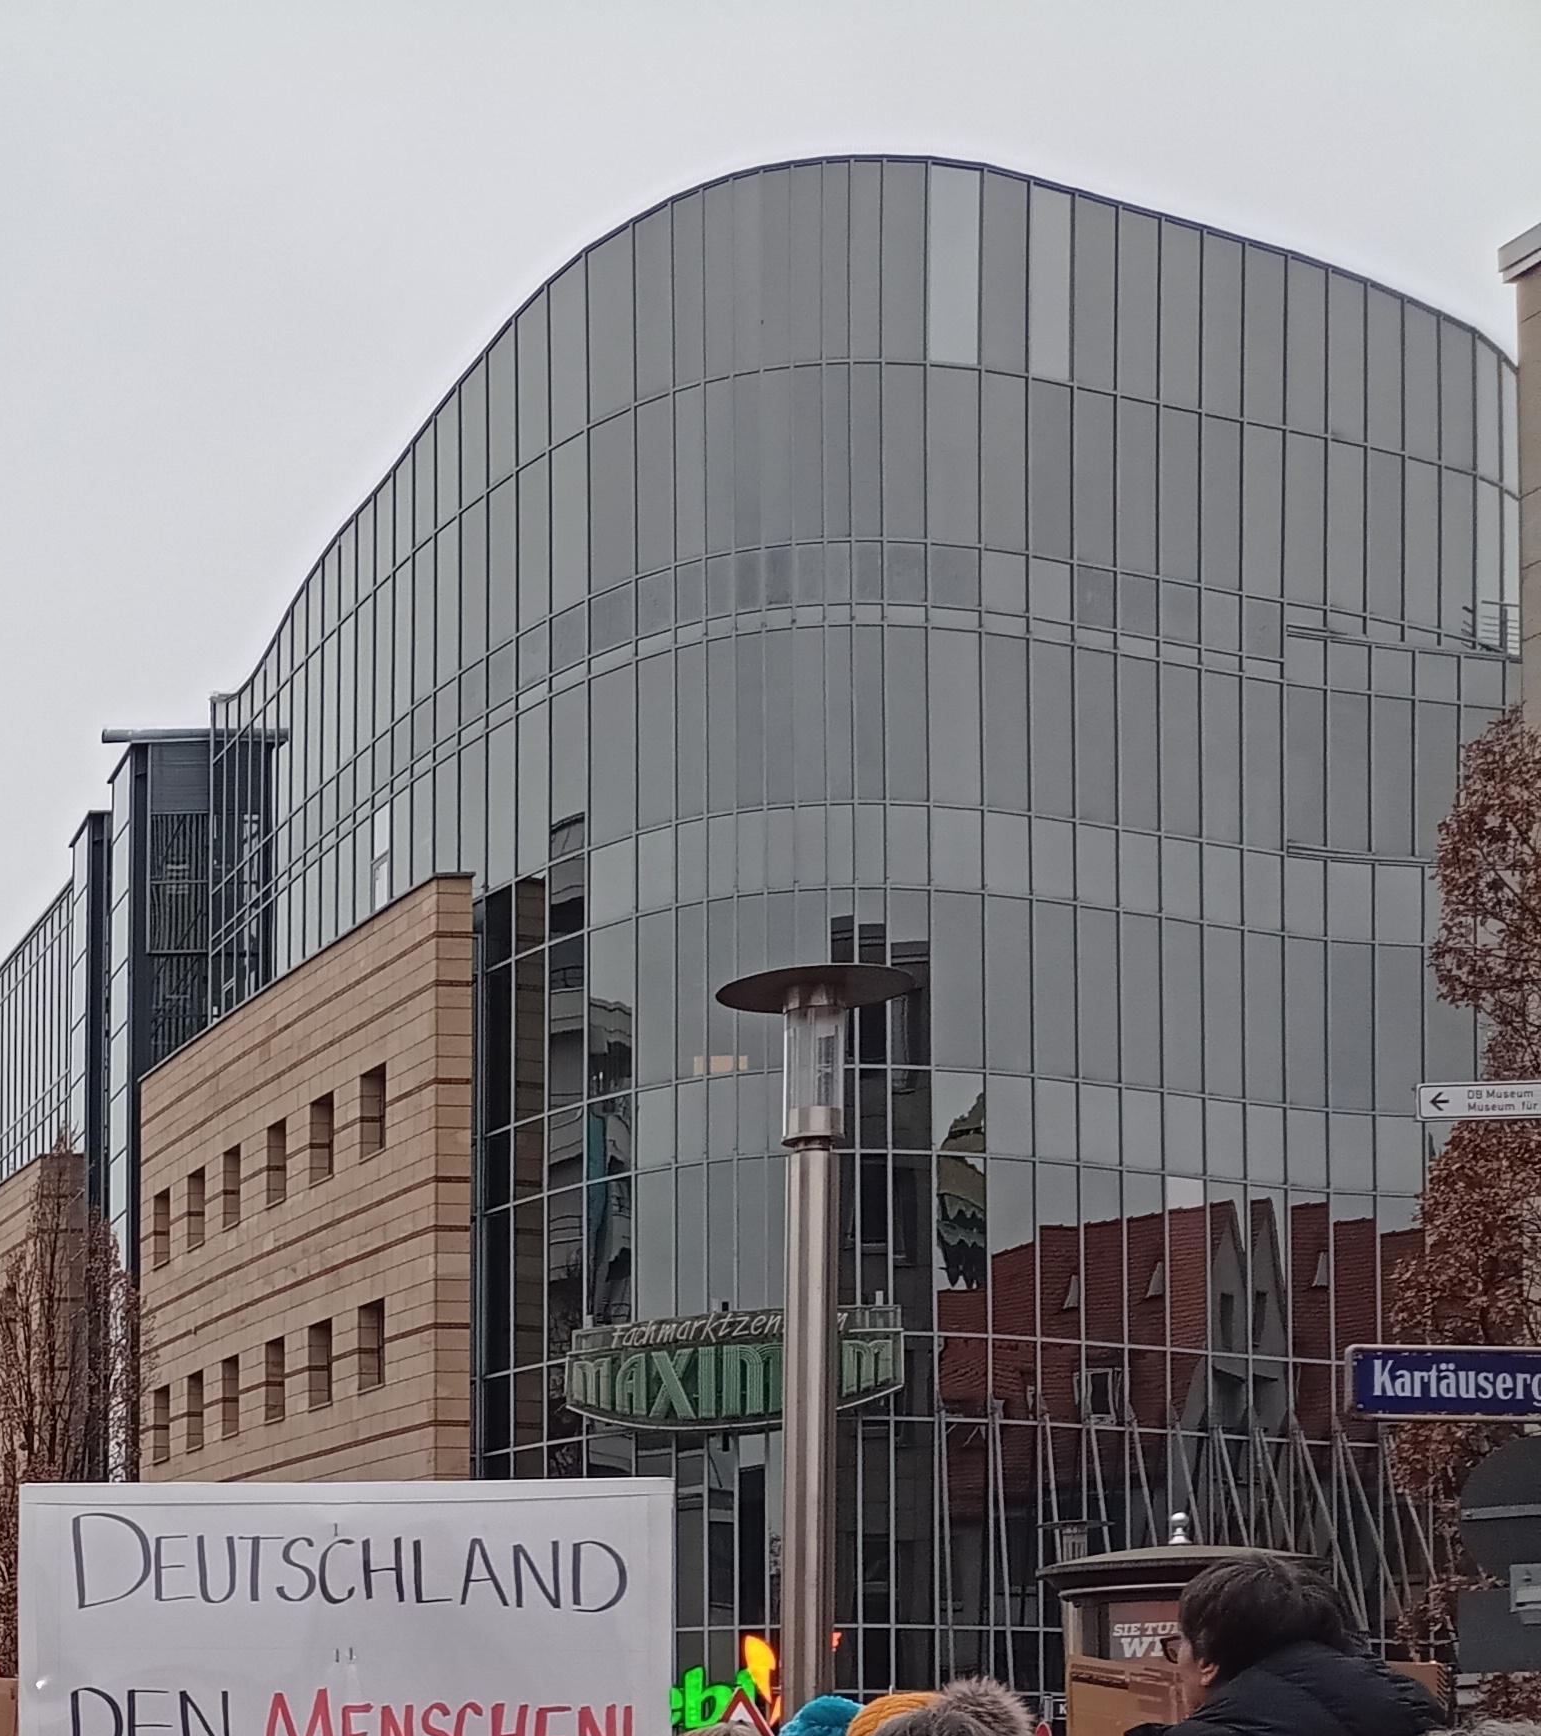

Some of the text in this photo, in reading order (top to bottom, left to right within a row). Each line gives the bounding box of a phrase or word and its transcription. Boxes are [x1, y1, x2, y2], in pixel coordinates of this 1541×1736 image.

[1486, 1089, 1534, 1099] Museum
[1467, 1101, 1539, 1112] Museum für
[71, 1512, 628, 1612] DEUTSCHLAND
